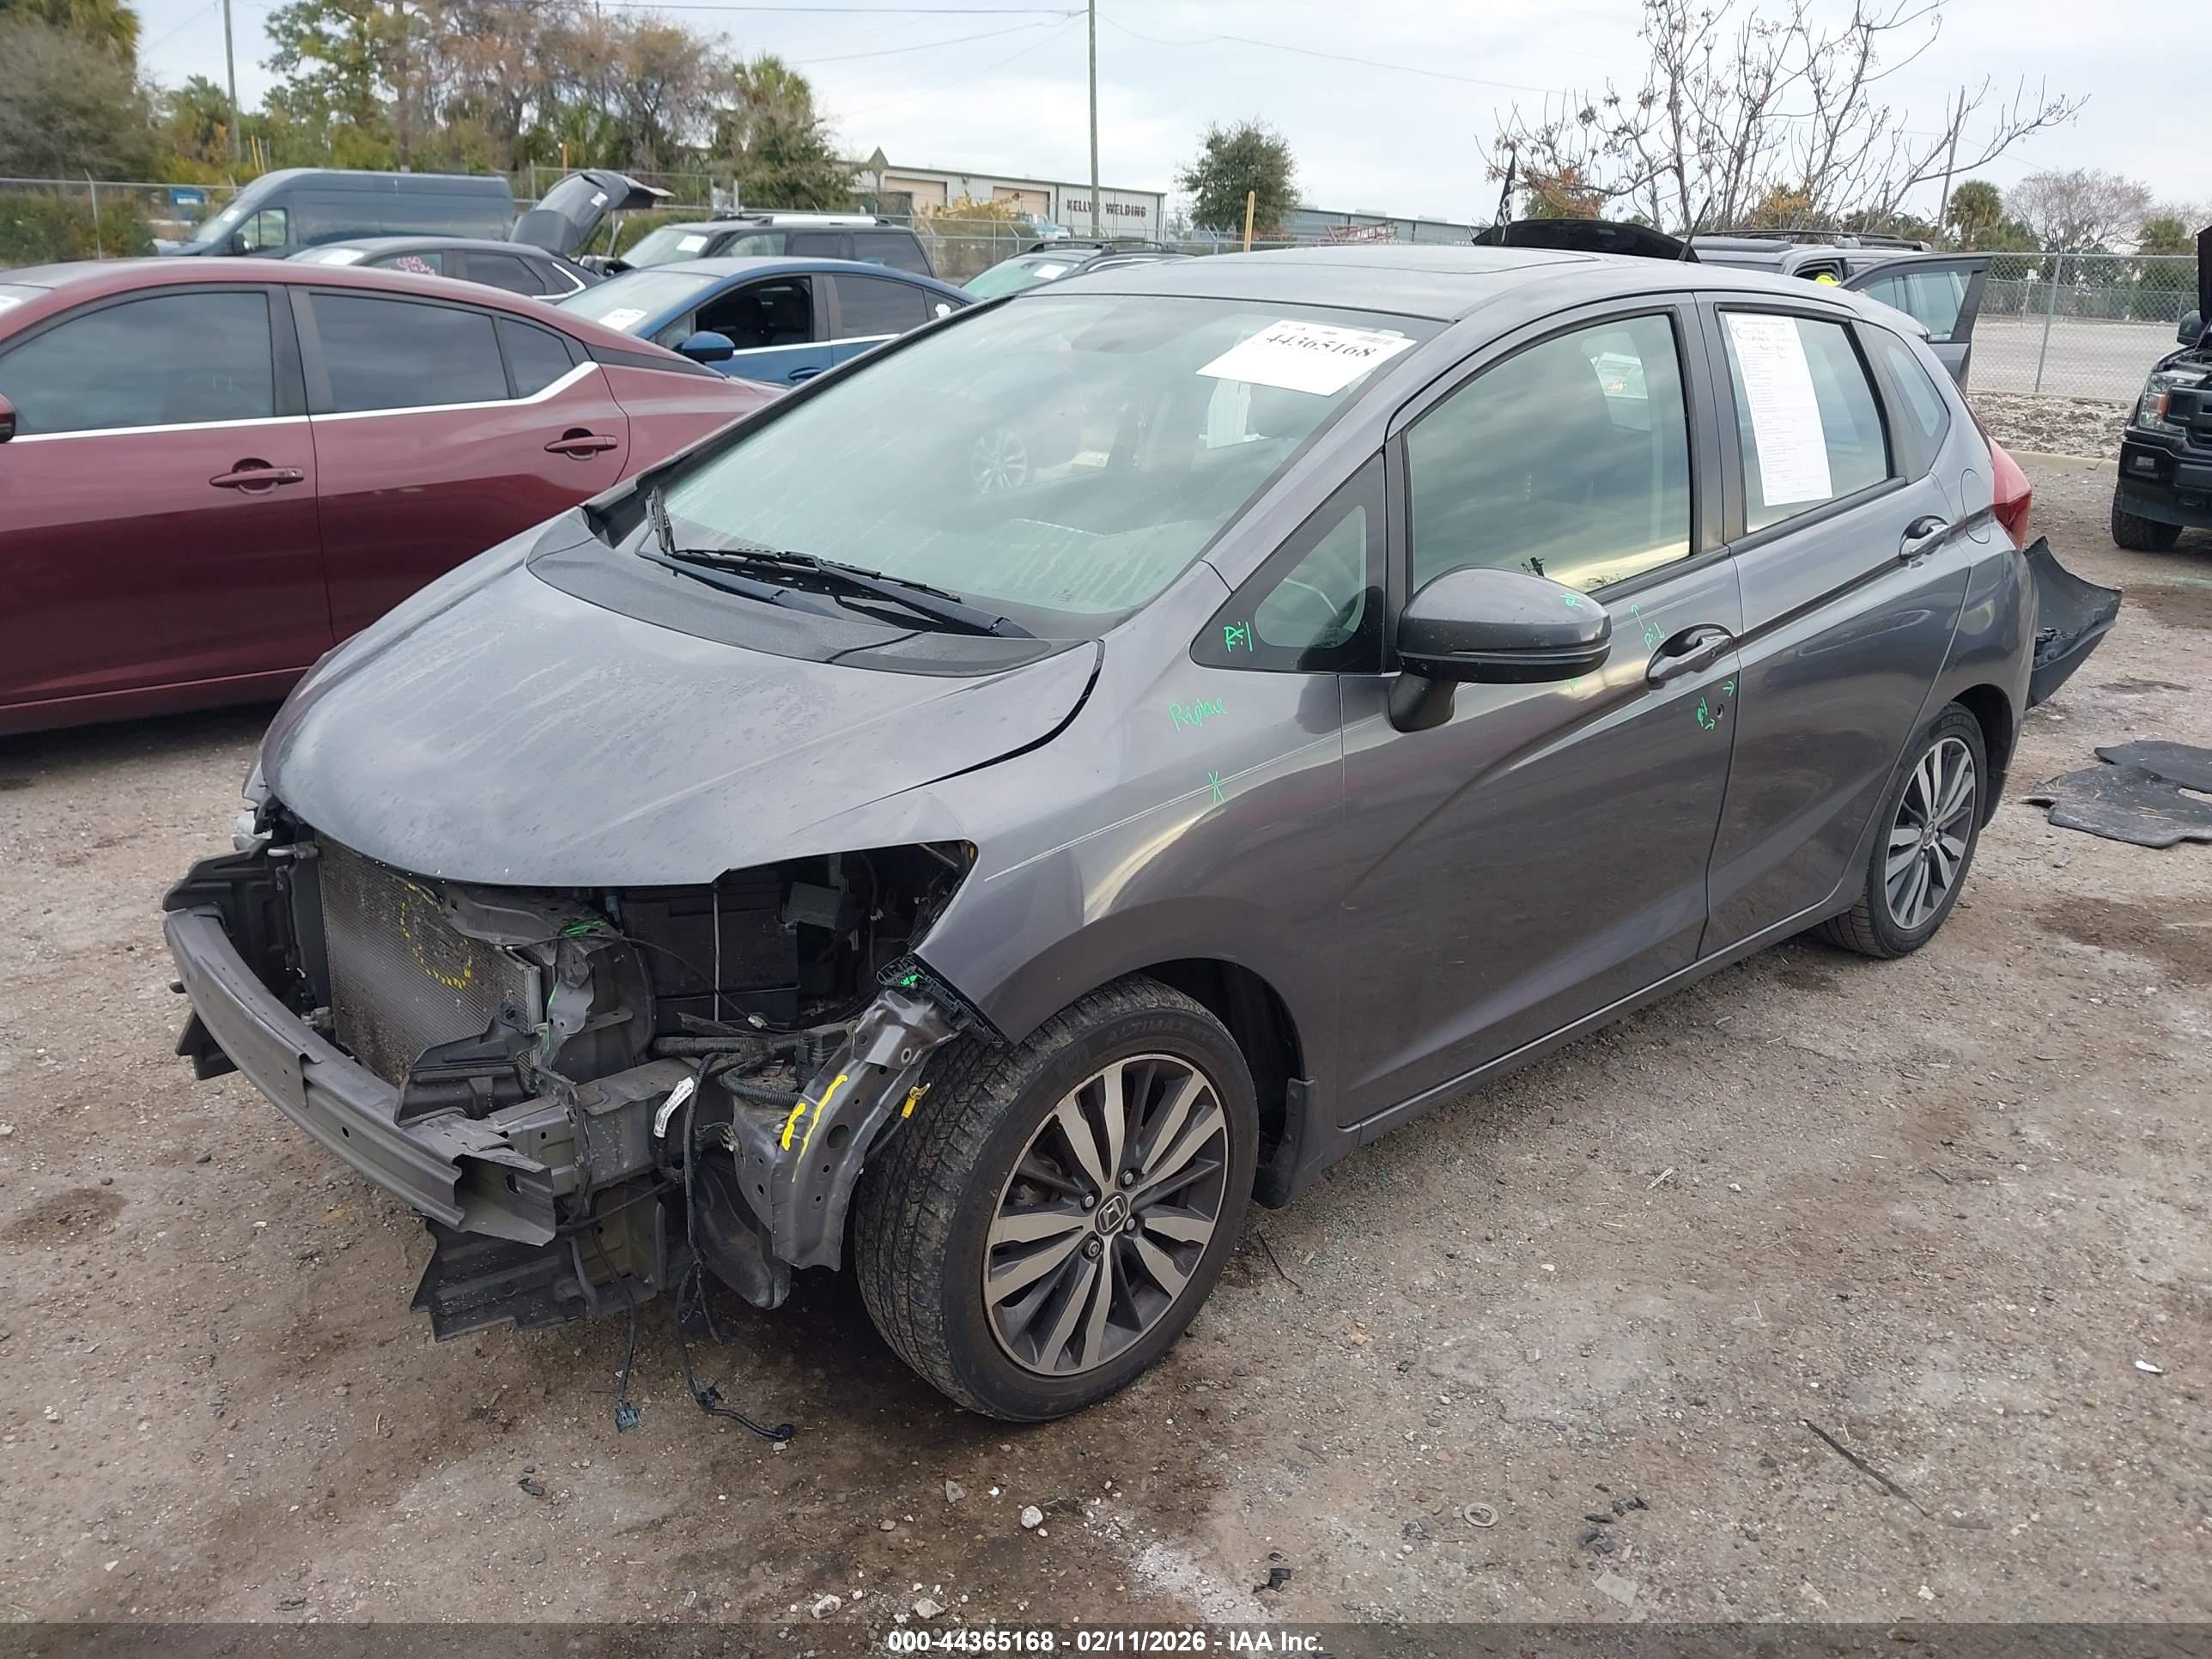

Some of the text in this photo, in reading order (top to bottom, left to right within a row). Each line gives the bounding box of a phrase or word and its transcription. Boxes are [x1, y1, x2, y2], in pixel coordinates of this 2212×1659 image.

[1105, 202, 1146, 217] WELDING
[1266, 332, 1377, 358] 44365168
[1106, 1018, 1188, 1046] ALTIMAX
